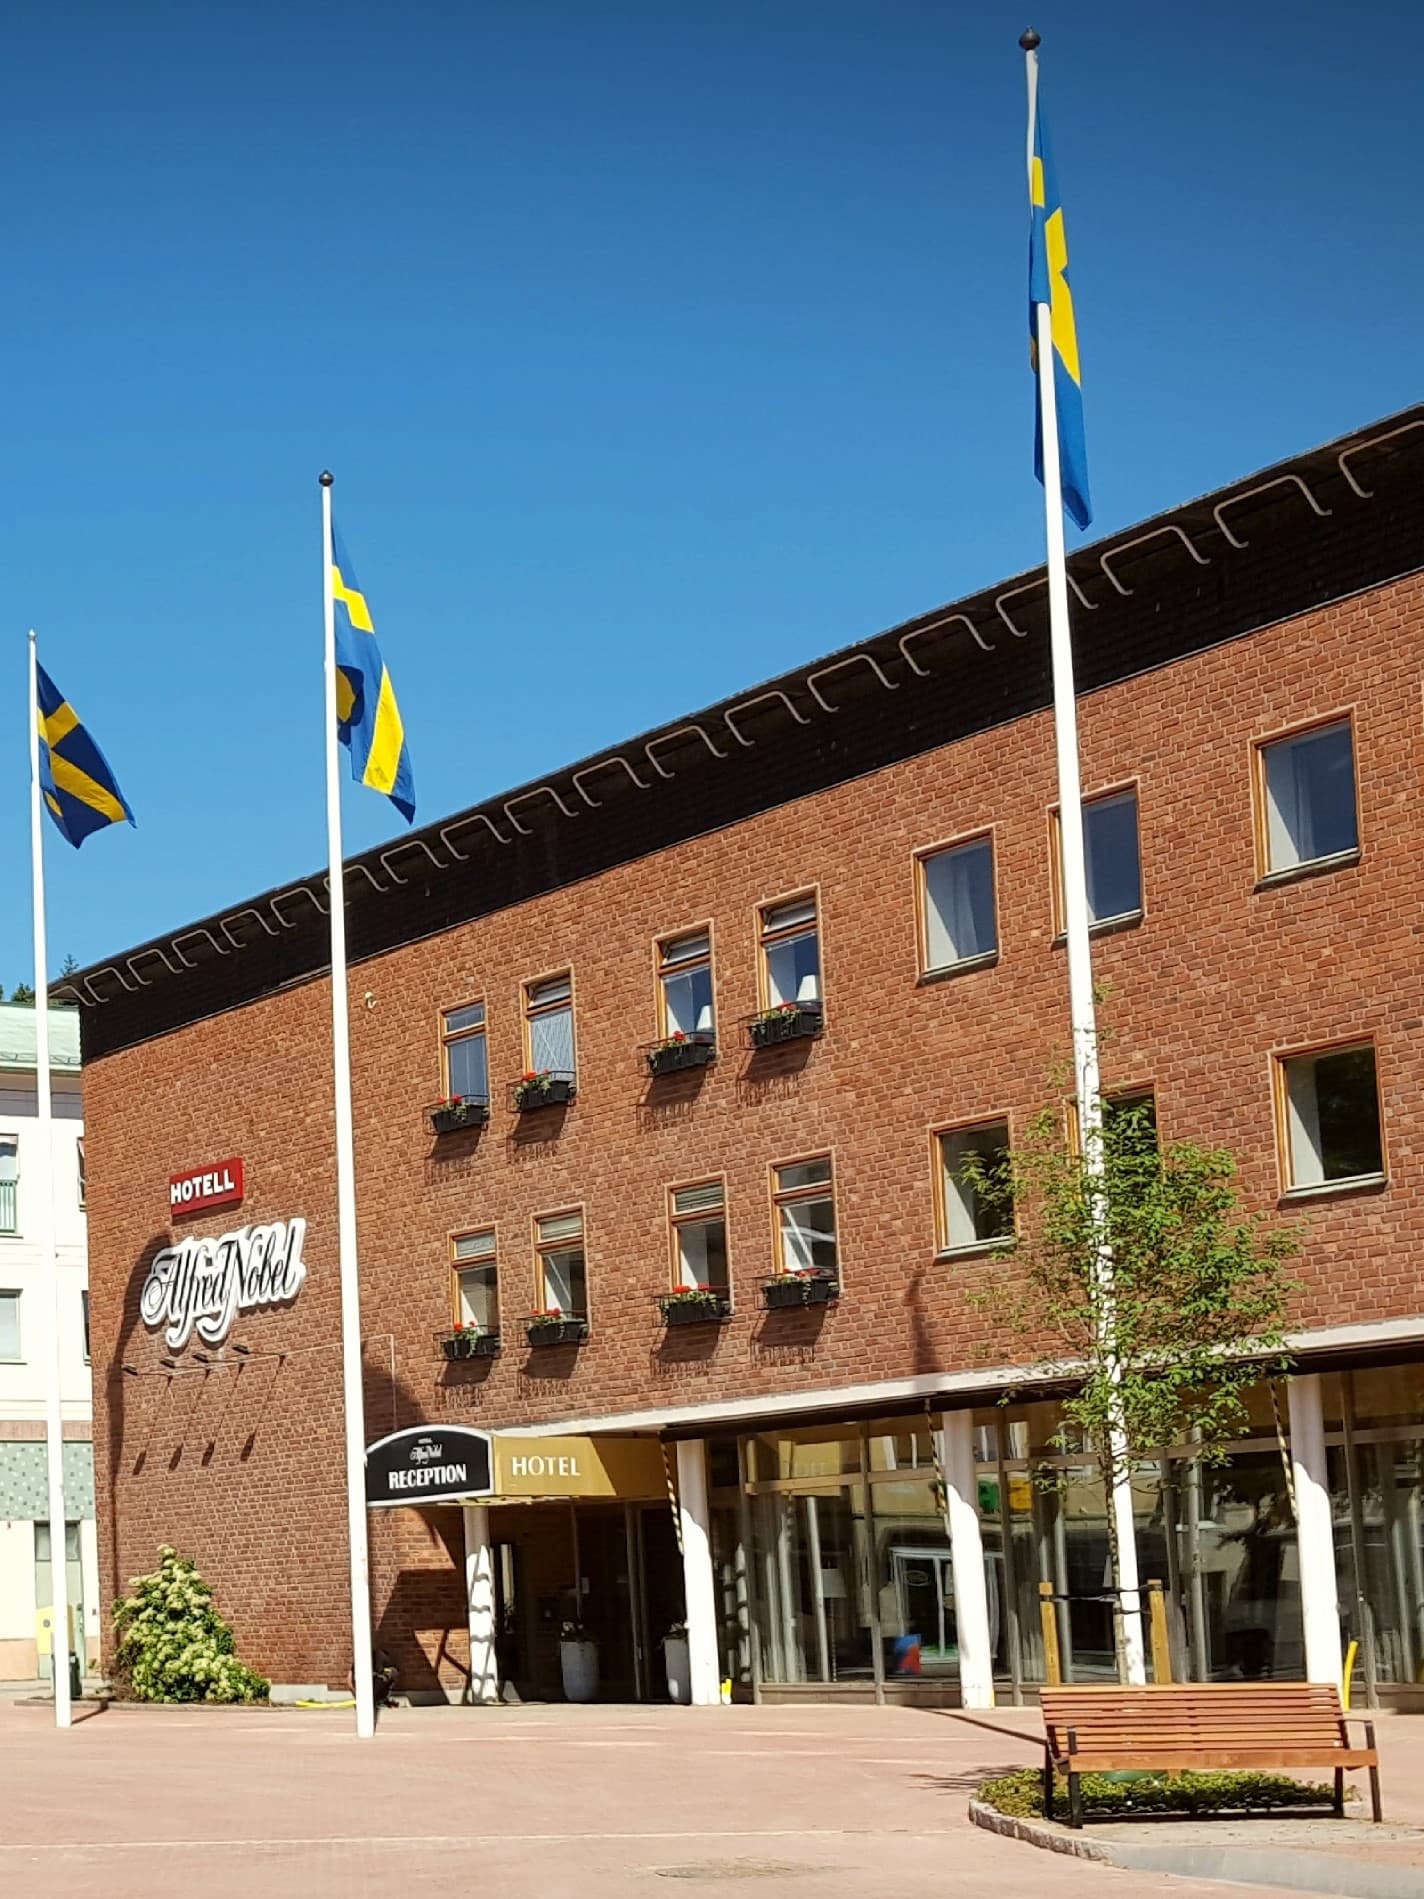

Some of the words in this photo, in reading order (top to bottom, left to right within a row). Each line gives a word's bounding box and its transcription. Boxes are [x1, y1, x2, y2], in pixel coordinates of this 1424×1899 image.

[170, 1168, 235, 1205] HOTELL
[144, 1241, 234, 1344] Alfred
[203, 1226, 297, 1334] Nobel
[388, 1463, 467, 1489] RECEPTION
[512, 1455, 581, 1476] HOTEL
